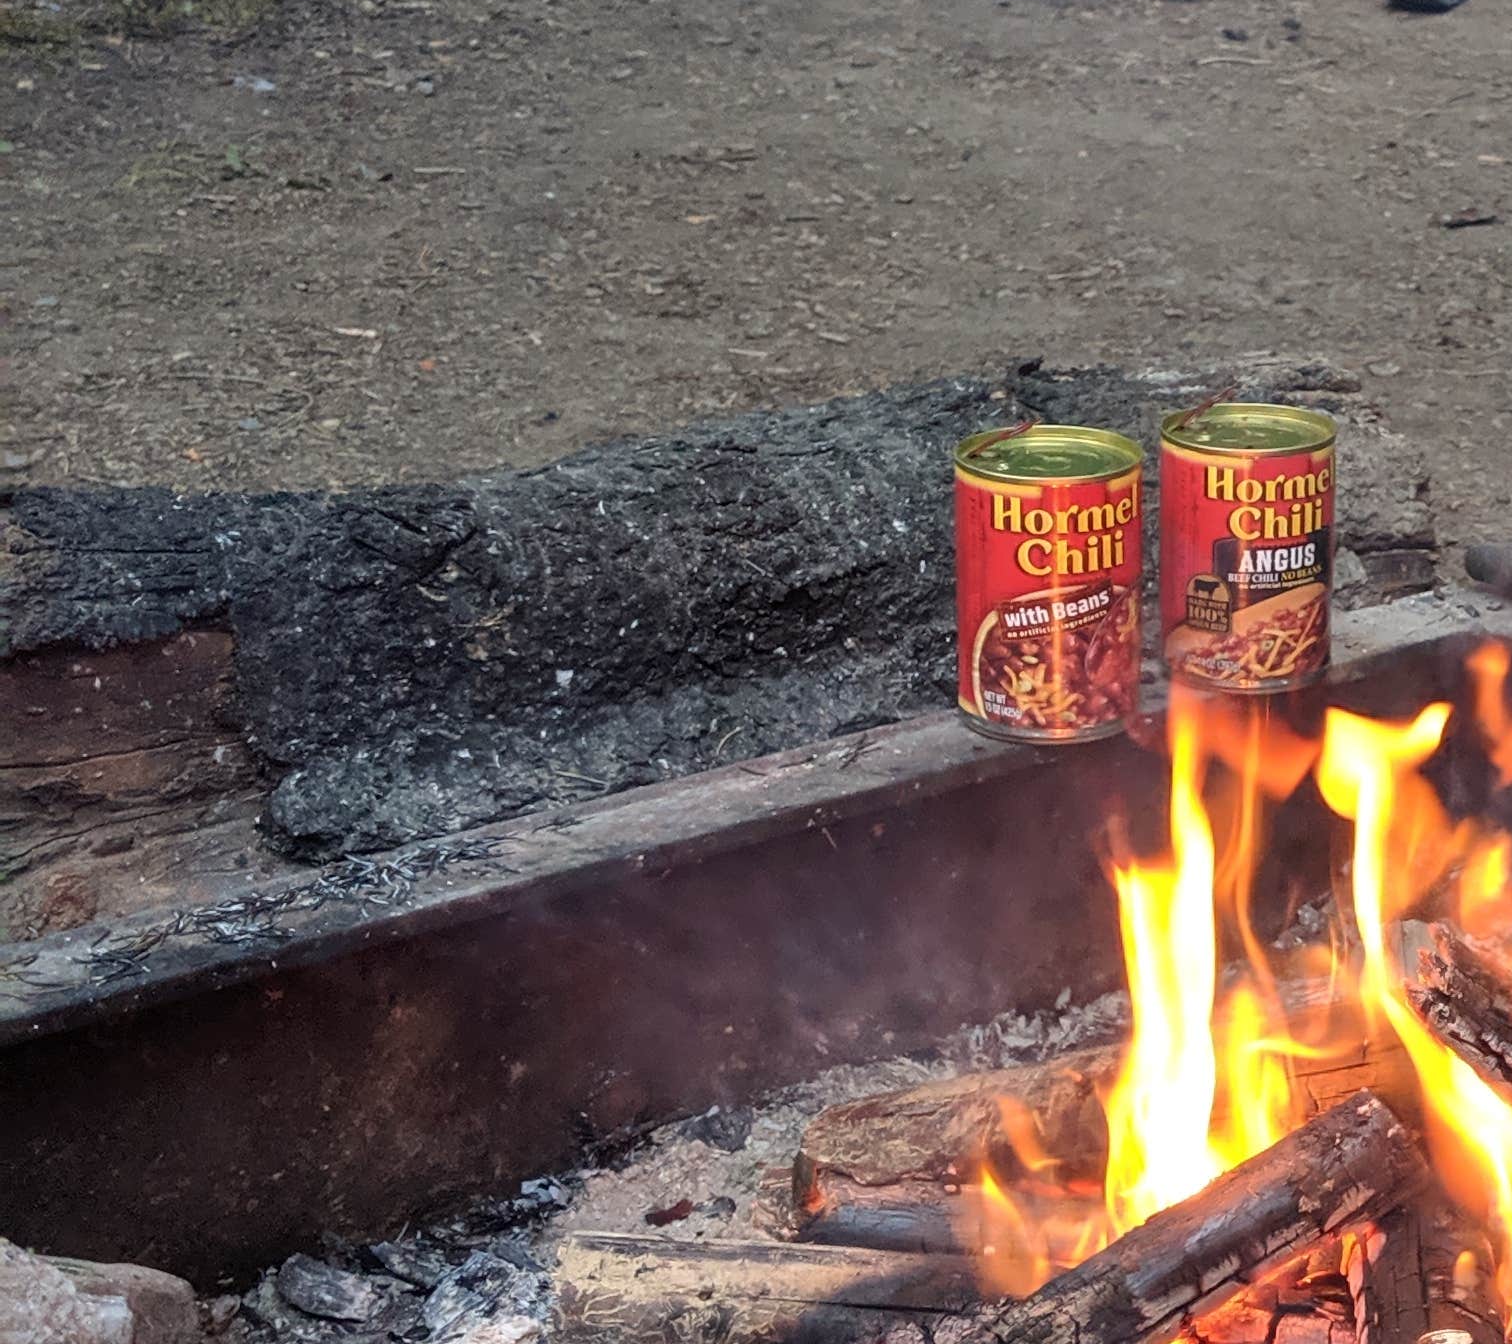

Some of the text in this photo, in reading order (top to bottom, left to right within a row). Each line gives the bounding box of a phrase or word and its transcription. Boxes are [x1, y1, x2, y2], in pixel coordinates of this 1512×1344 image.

[1207, 456, 1334, 504] Hormel
[993, 485, 1137, 535] Hormel
[1229, 498, 1323, 541] Chili
[1017, 530, 1124, 576] Chili
[1239, 543, 1316, 573] ANGUS
[1228, 573, 1250, 584] BEEF
[1252, 572, 1279, 583] CHILI
[1281, 570, 1296, 581] NO
[1004, 589, 1110, 628] with Beans
[1188, 605, 1228, 624] 100%
[1007, 630, 1018, 638] no
